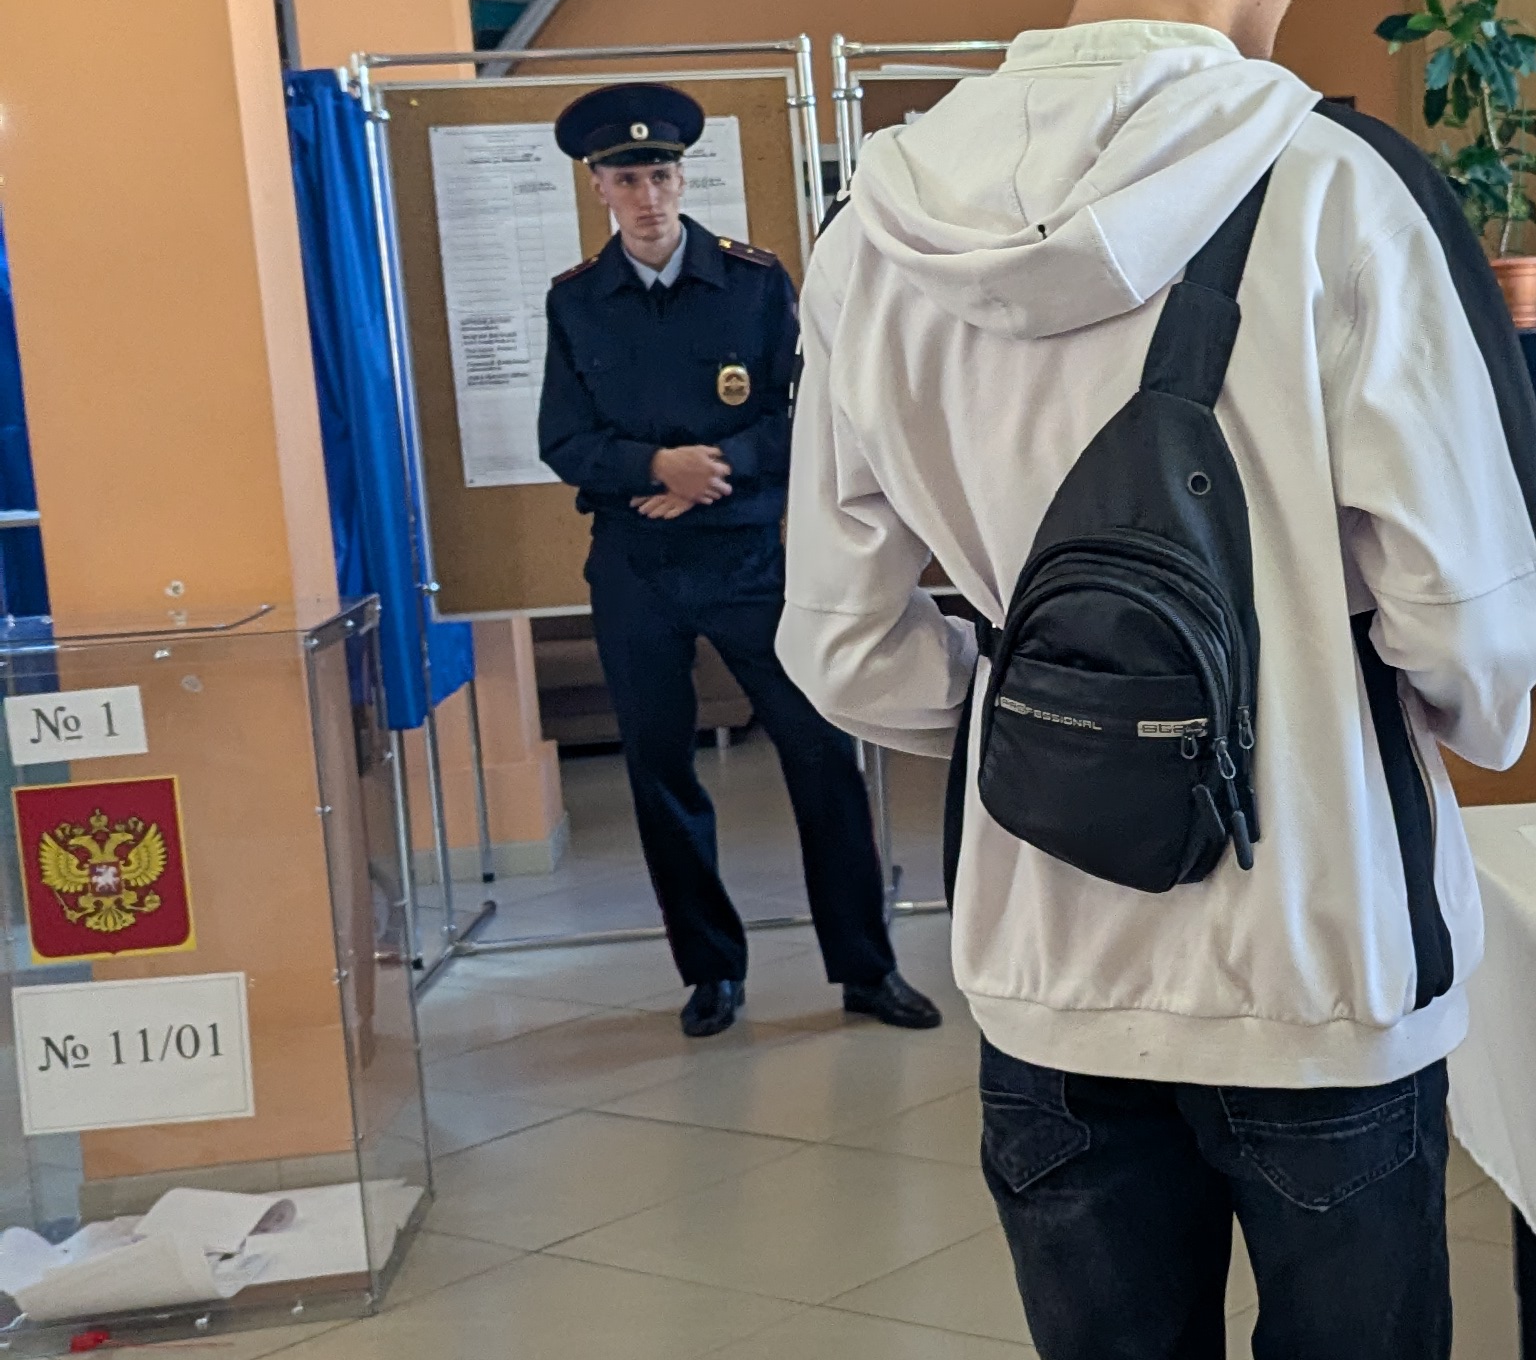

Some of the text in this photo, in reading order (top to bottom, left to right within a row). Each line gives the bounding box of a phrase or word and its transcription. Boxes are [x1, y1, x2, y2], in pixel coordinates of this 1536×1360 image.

[29, 703, 120, 745] № 1
[38, 1021, 225, 1072] № 11/01
